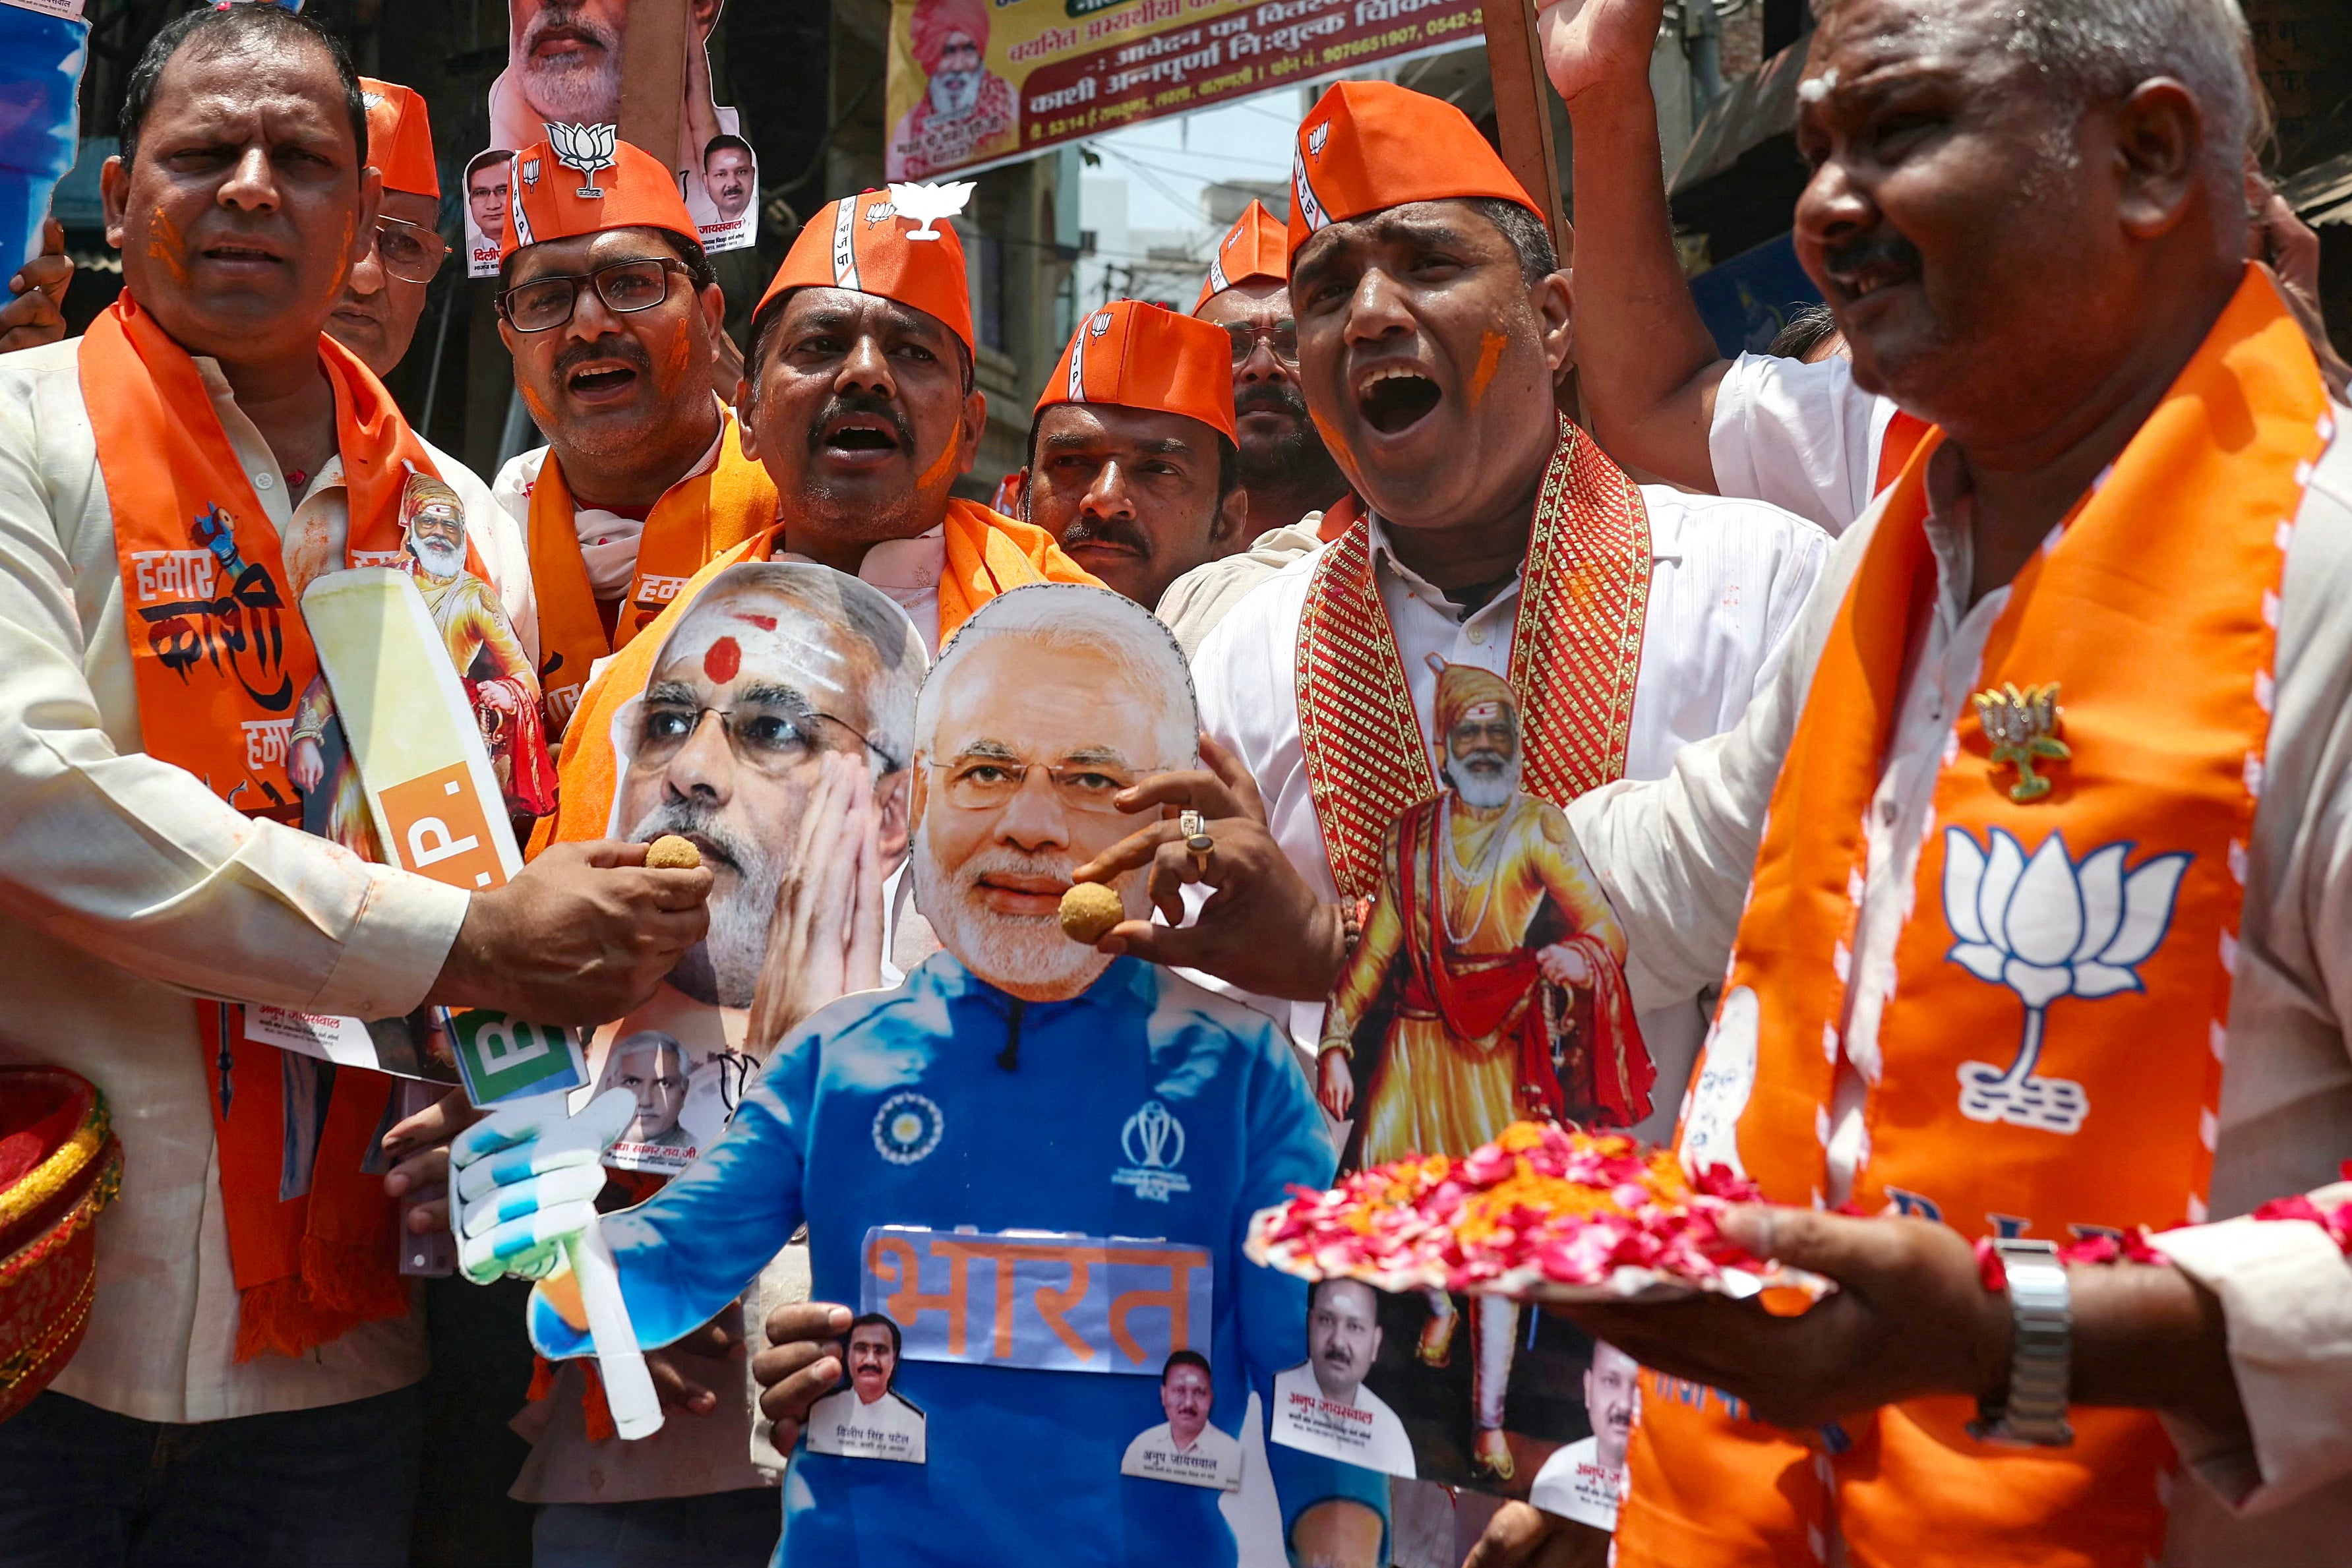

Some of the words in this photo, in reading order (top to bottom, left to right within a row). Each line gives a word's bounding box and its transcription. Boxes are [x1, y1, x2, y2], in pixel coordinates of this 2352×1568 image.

[1114, 29, 1201, 65] आवेदन
[1029, 76, 1096, 113] काशी
[1105, 42, 1221, 94] अन्नपूर्णा
[698, 220, 742, 233] जायसवाल
[132, 549, 215, 601] हमार
[137, 562, 293, 711] काशी
[241, 718, 295, 771] हमा
[632, 1145, 660, 1154] सागर
[663, 1148, 679, 1157] राय
[682, 1146, 696, 1159] जी
[868, 1237, 1207, 1365] भारत
[1320, 1401, 1373, 1425] जायसवाल
[866, 1428, 885, 1441] सिंह
[888, 1432, 909, 1444] पटेल
[1170, 1453, 1217, 1470] जायसवाल
